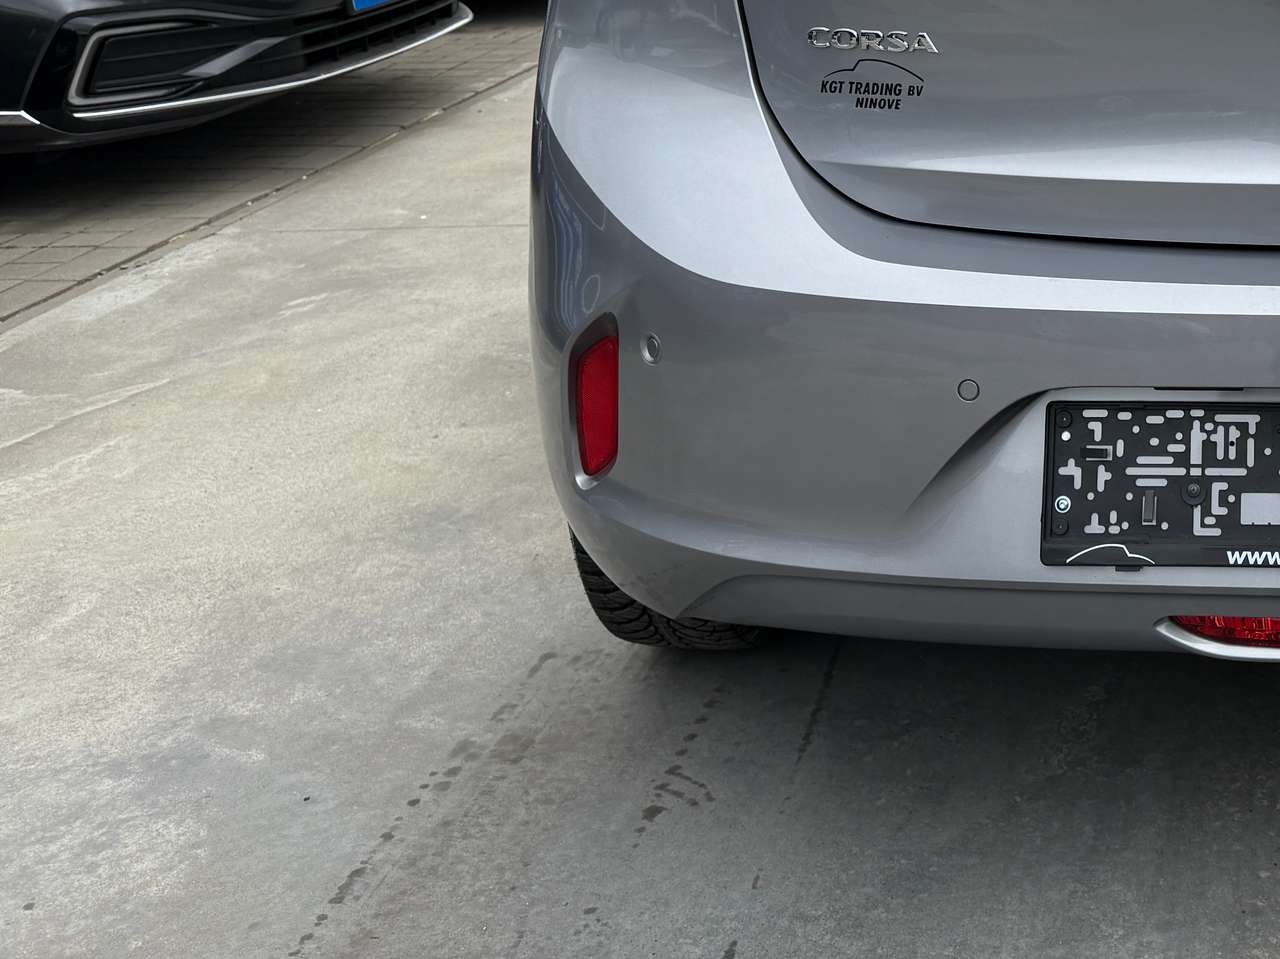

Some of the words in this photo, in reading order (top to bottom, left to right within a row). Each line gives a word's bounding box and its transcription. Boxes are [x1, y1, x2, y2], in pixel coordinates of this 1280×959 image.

[807, 26, 939, 54] CORSA
[820, 80, 845, 94] KGT
[848, 81, 902, 96] TRADING
[907, 85, 924, 97] BV
[855, 97, 902, 110] NINOVE
